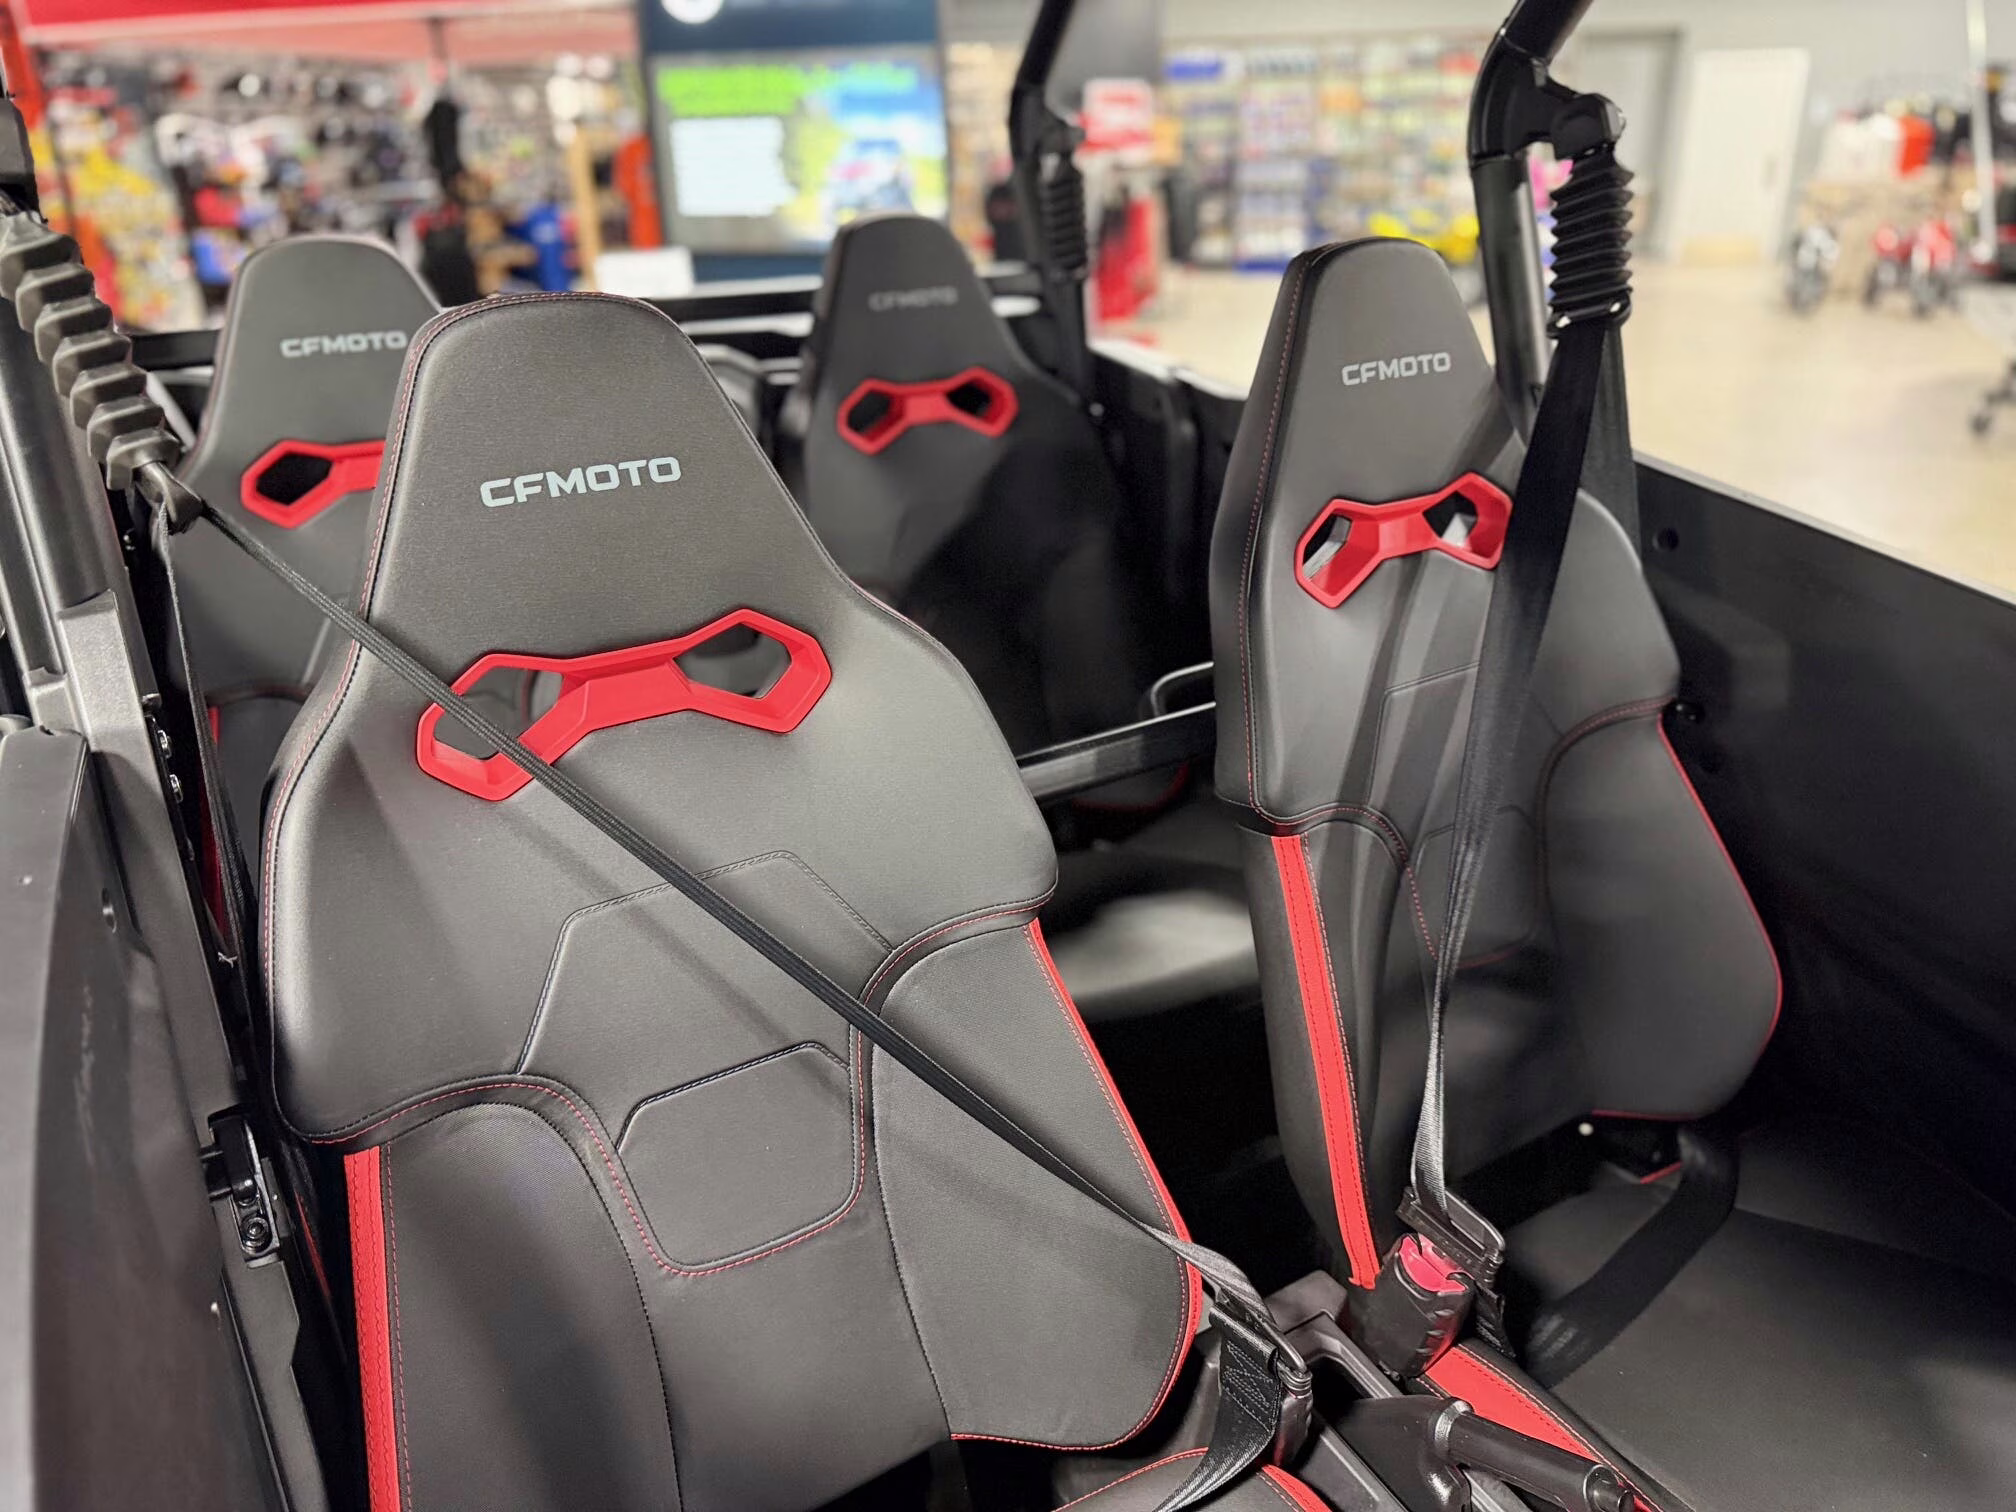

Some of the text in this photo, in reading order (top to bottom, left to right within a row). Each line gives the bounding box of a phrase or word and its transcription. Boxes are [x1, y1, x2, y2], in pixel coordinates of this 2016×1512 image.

[279, 330, 408, 358] CFMOTO
[1341, 352, 1452, 386] CFMOTO
[480, 456, 682, 508] CFMOTO
